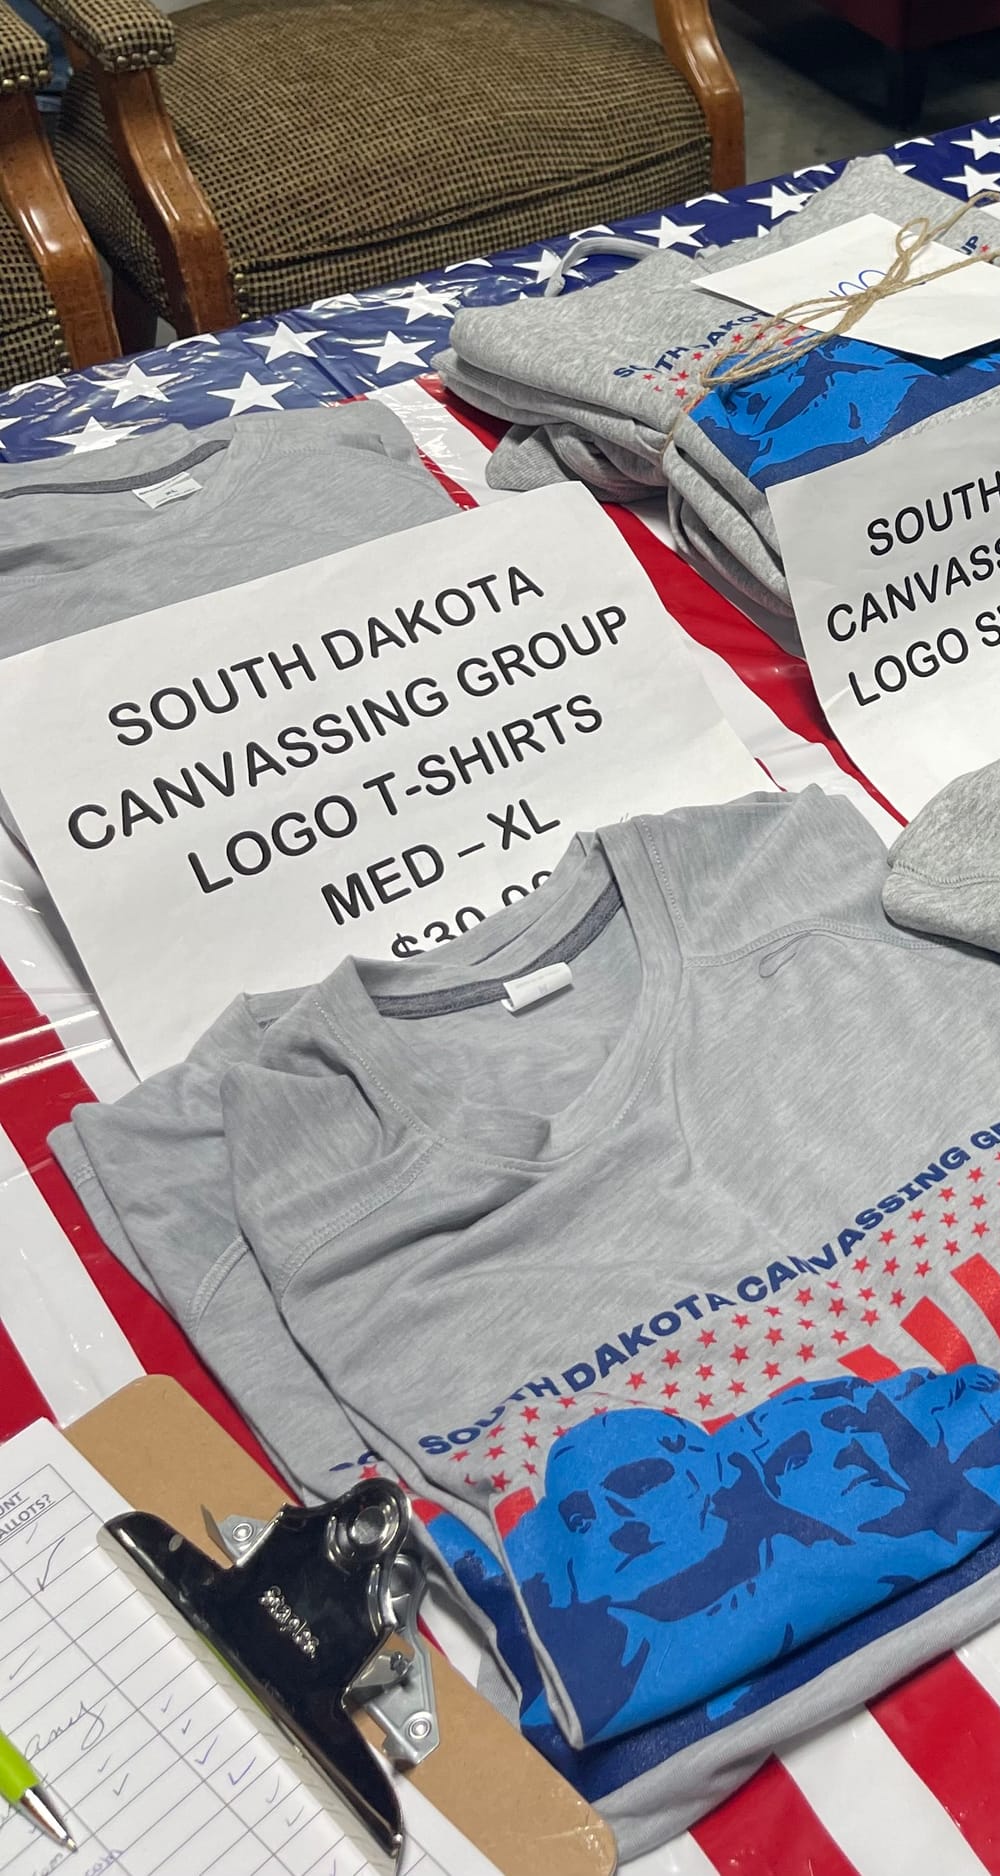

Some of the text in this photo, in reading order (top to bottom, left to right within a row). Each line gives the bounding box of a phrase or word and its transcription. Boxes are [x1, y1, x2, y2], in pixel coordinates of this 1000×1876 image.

[67, 605, 628, 850] CANVASSING GROUP
[107, 565, 545, 747] SOUTH DAKOTA
[847, 626, 970, 707] LOGO
[186, 693, 604, 895] LOGO T-SHIRTS
[320, 843, 445, 926] MED
[487, 798, 562, 852] XL
[417, 1375, 563, 1456] SOUTH
[560, 1292, 738, 1394] DAKOTA
[736, 1146, 972, 1303] CANVASSING
[0, 1493, 51, 1538] ALLOTS?
